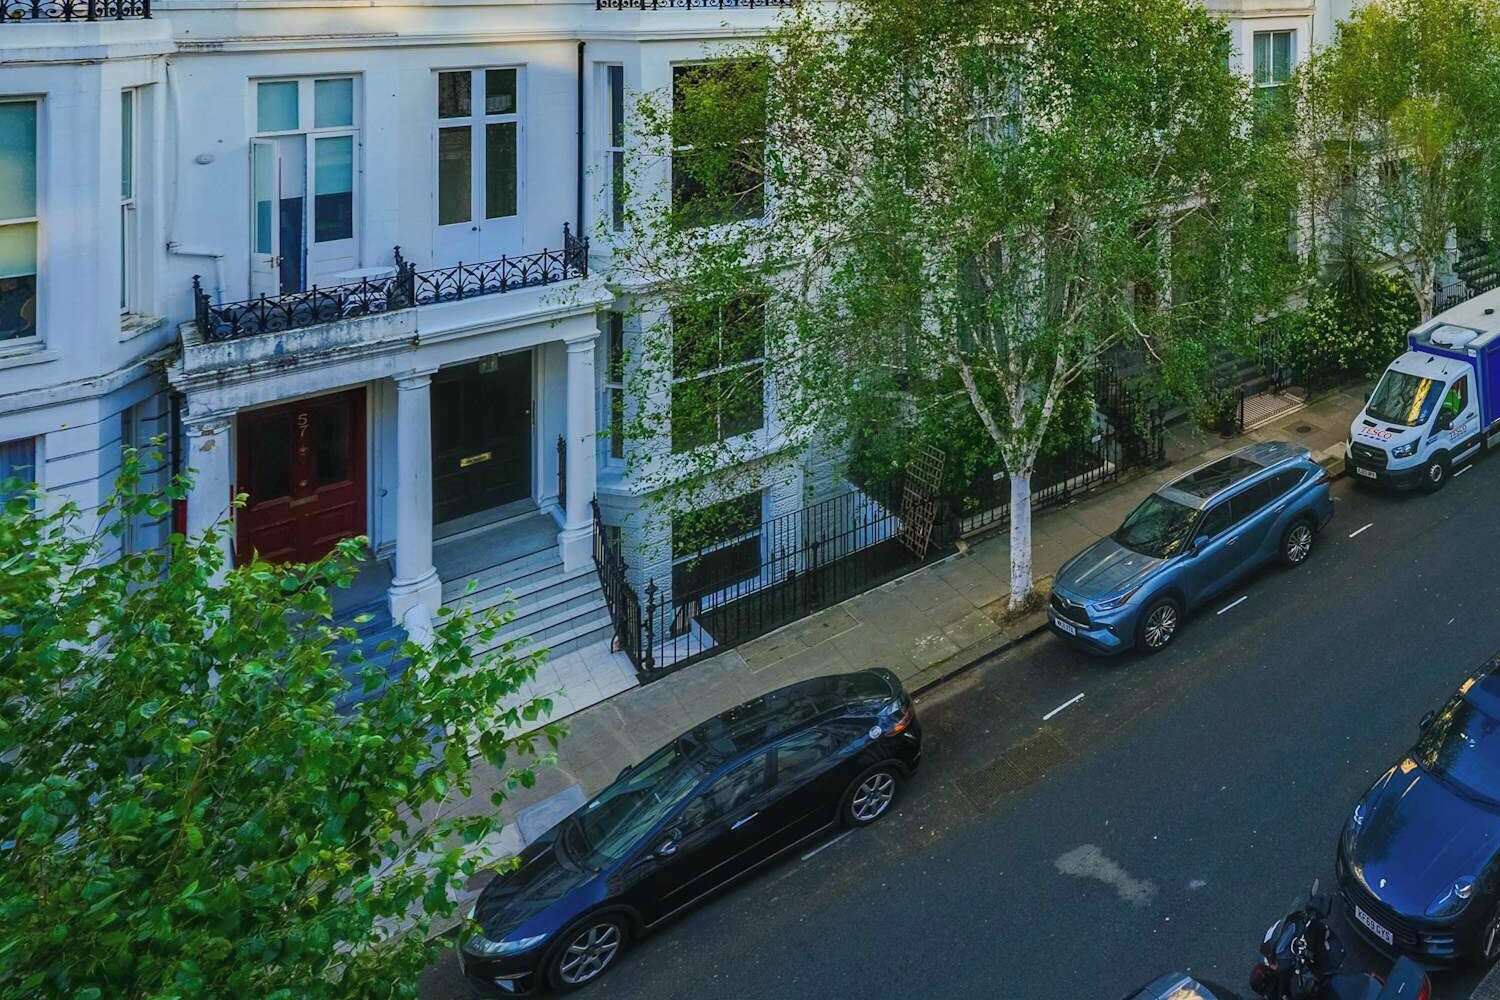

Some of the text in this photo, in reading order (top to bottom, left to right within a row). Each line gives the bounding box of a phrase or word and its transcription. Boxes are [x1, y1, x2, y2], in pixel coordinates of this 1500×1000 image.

[297, 413, 308, 437] 57
[1449, 424, 1467, 438] TESCO
[1360, 426, 1392, 440] TESCO
